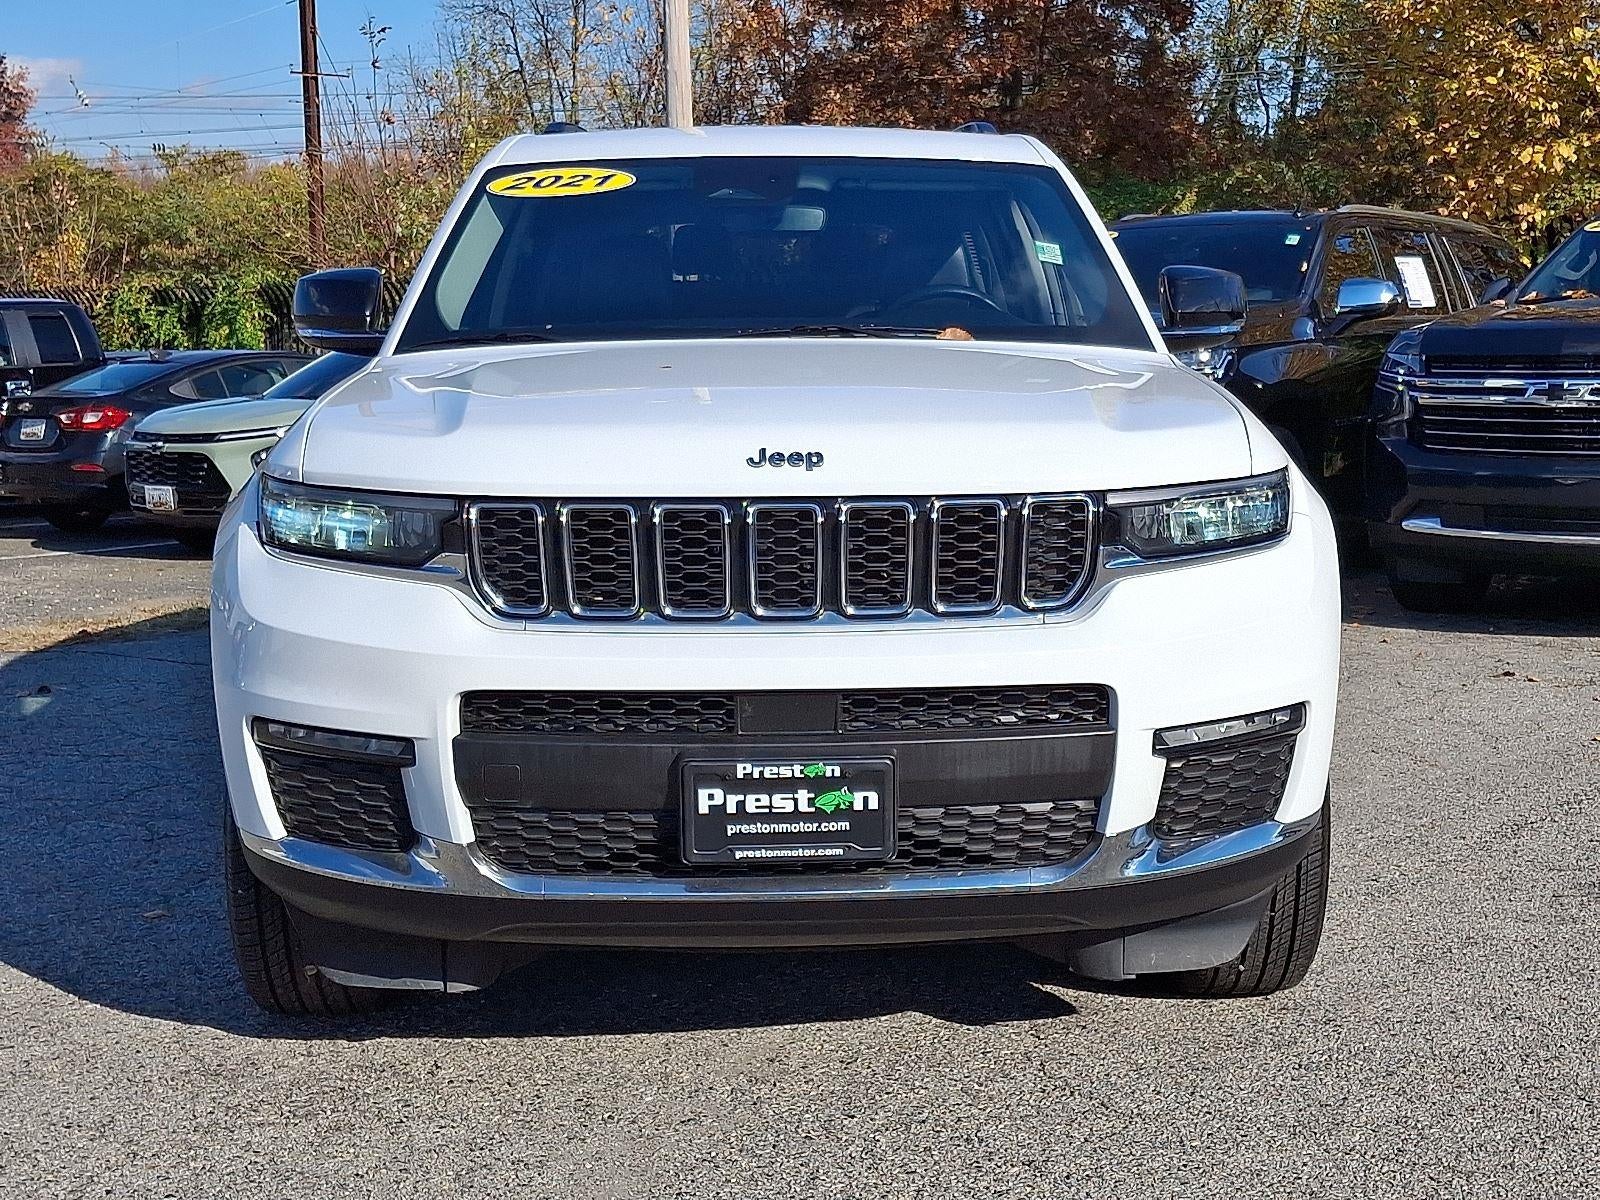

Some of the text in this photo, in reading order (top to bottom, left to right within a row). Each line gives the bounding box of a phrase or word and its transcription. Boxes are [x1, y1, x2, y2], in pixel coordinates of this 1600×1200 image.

[499, 173, 617, 192] 2021
[745, 447, 824, 471] Jeep
[726, 821, 851, 836] prestonmotor.com
[735, 847, 844, 859] prestonmotor.com
